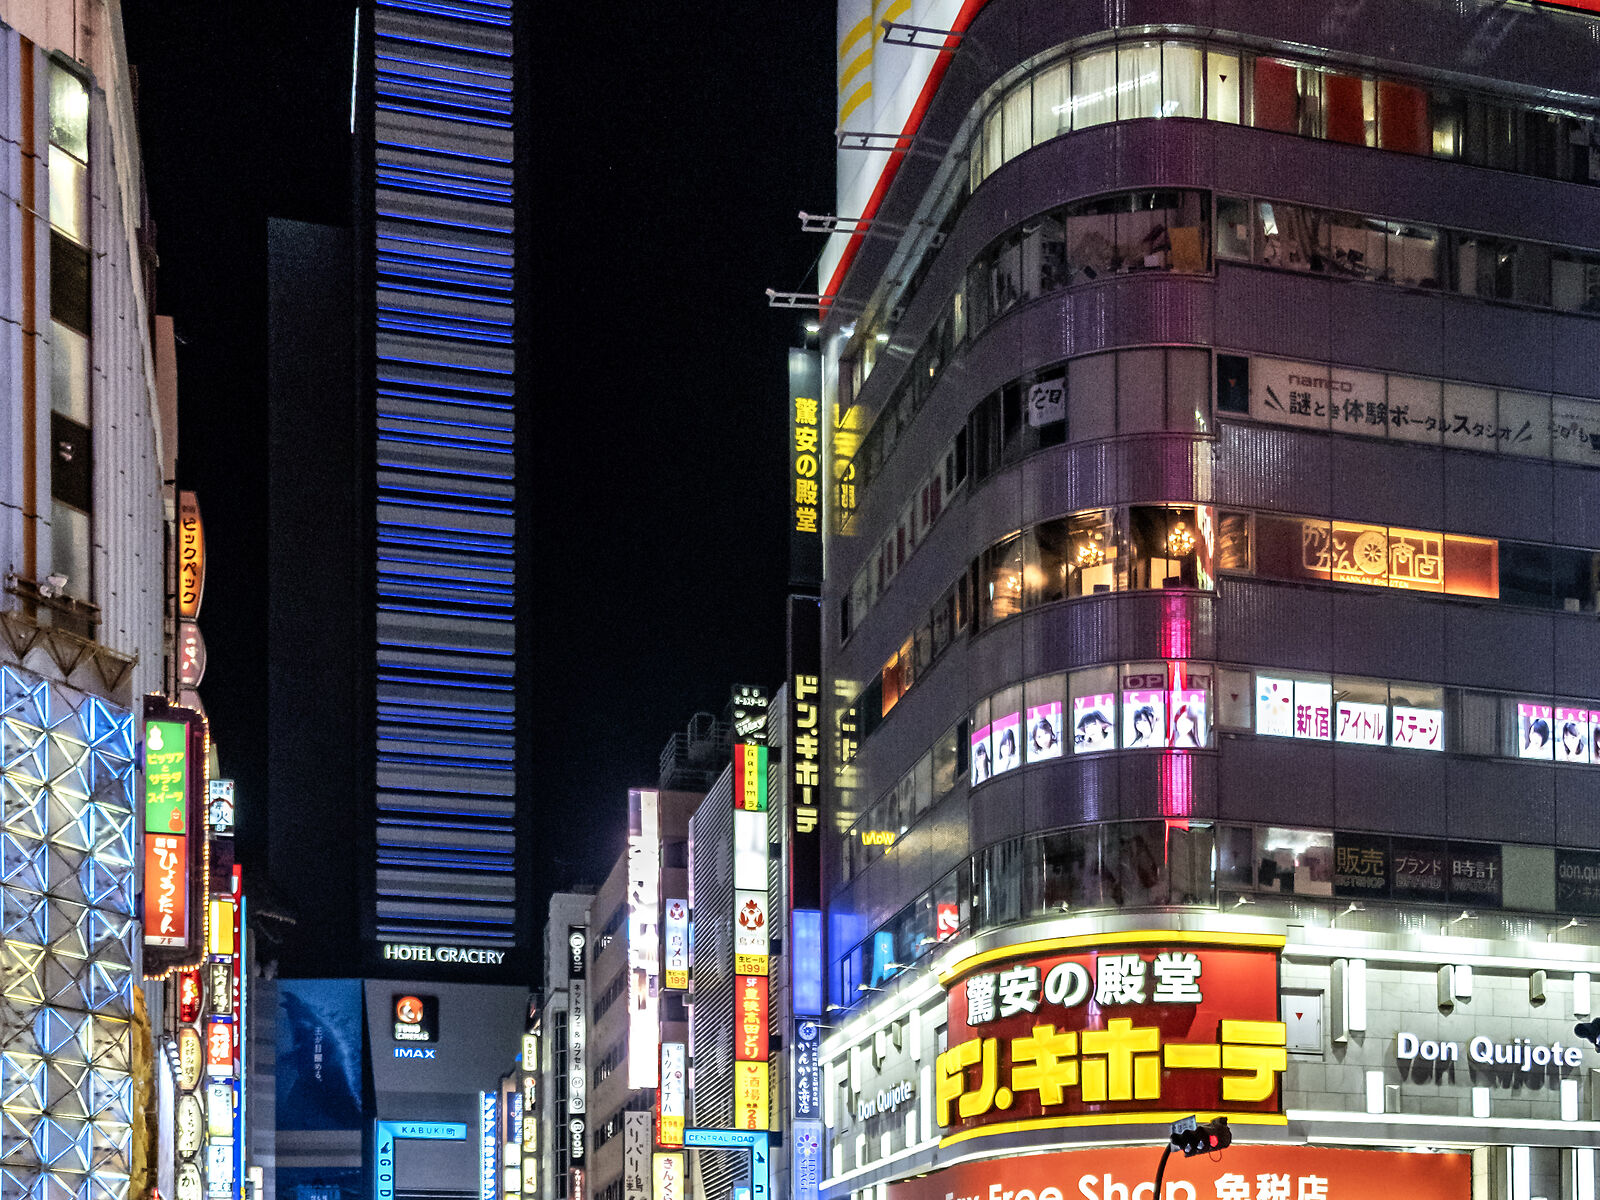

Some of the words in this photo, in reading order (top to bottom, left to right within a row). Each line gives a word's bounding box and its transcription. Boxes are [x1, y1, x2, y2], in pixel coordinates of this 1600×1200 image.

[1288, 374, 1352, 392] namco
[795, 397, 818, 533] 驚安の殿堂
[1126, 676, 1209, 690] OPN
[1297, 704, 1329, 737] 新宿
[1337, 847, 1385, 876] 販売
[1395, 857, 1441, 875] ブランド
[1452, 860, 1497, 878] 時計
[153, 848, 178, 934] ひょうたん
[383, 945, 435, 962] HOTEL
[436, 948, 505, 965] GRACERY
[670, 977, 686, 985] 199
[966, 952, 1203, 1026] 驚安の殿堂
[394, 1048, 436, 1059] IMAX
[1397, 1032, 1459, 1061] Don
[1470, 1036, 1584, 1071] Quijote
[858, 1099, 875, 1122] Don
[877, 1079, 912, 1113] Quijote
[688, 1134, 728, 1143] CENTRAL
[732, 1135, 755, 1143] ROAD
